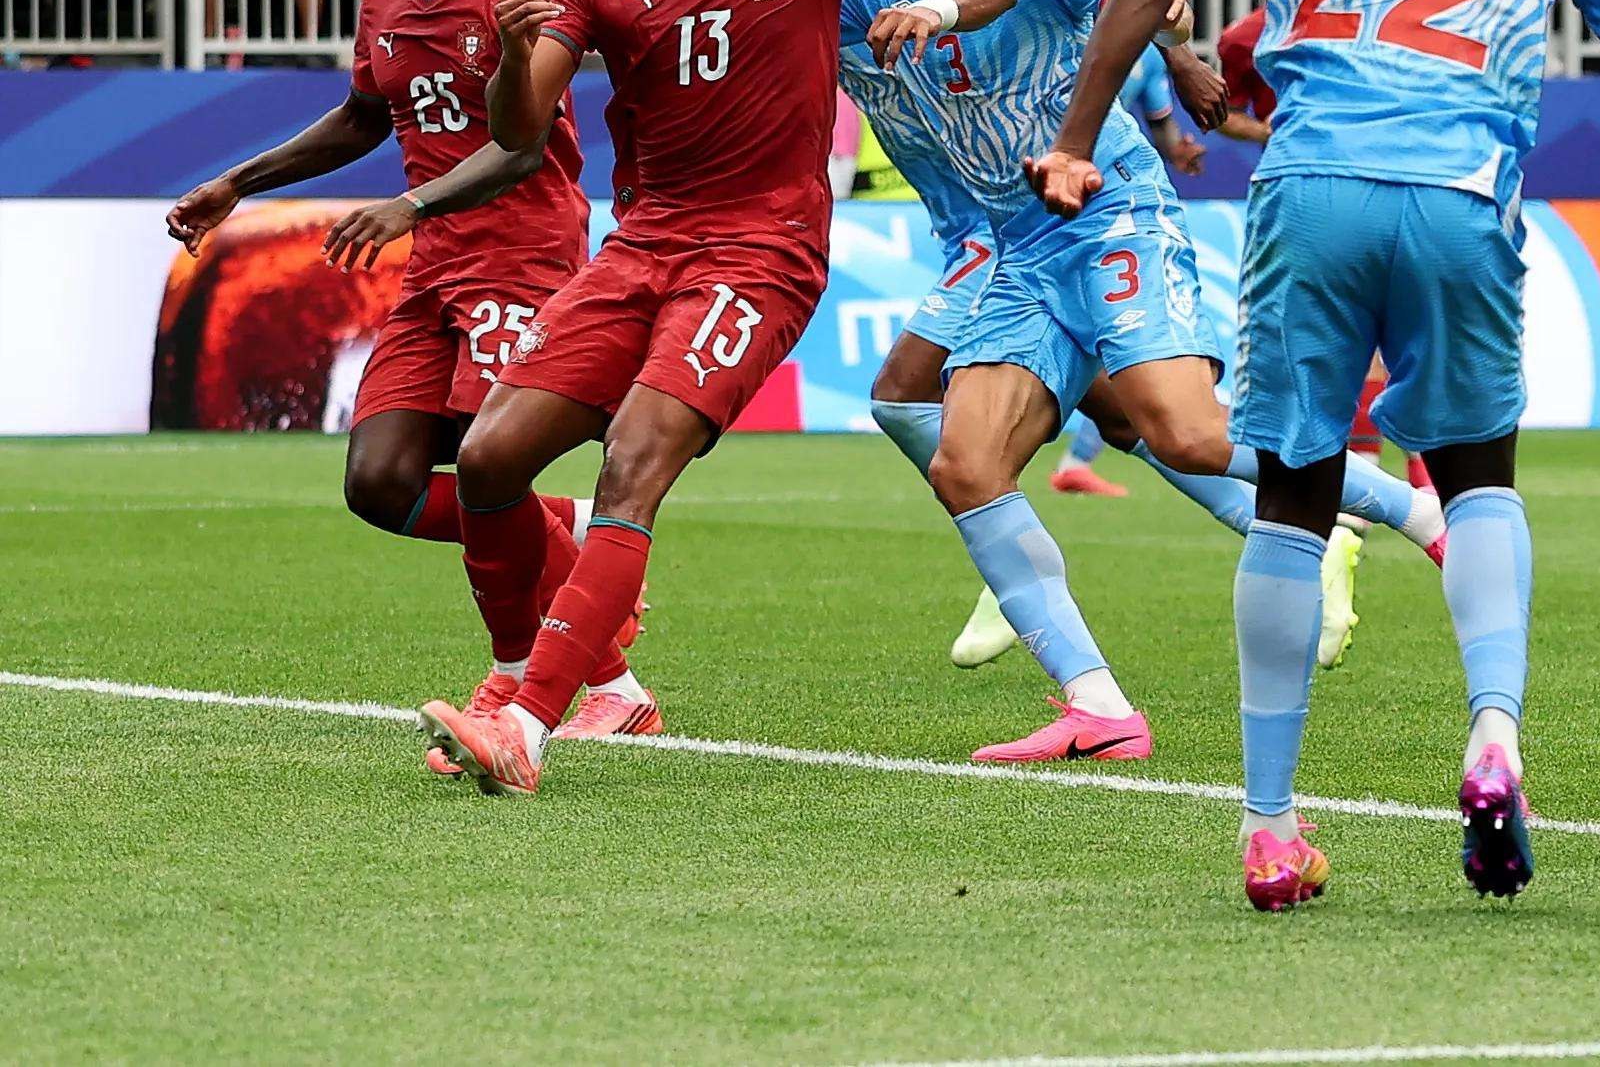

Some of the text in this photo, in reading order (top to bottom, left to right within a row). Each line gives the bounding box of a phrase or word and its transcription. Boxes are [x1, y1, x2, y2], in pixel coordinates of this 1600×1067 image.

[674, 8, 732, 85] 13
[936, 34, 972, 95] 3
[410, 72, 469, 134] 25
[942, 240, 992, 289] 7
[1100, 248, 1141, 303] 3
[469, 299, 536, 366] 25
[691, 284, 764, 368] 13
